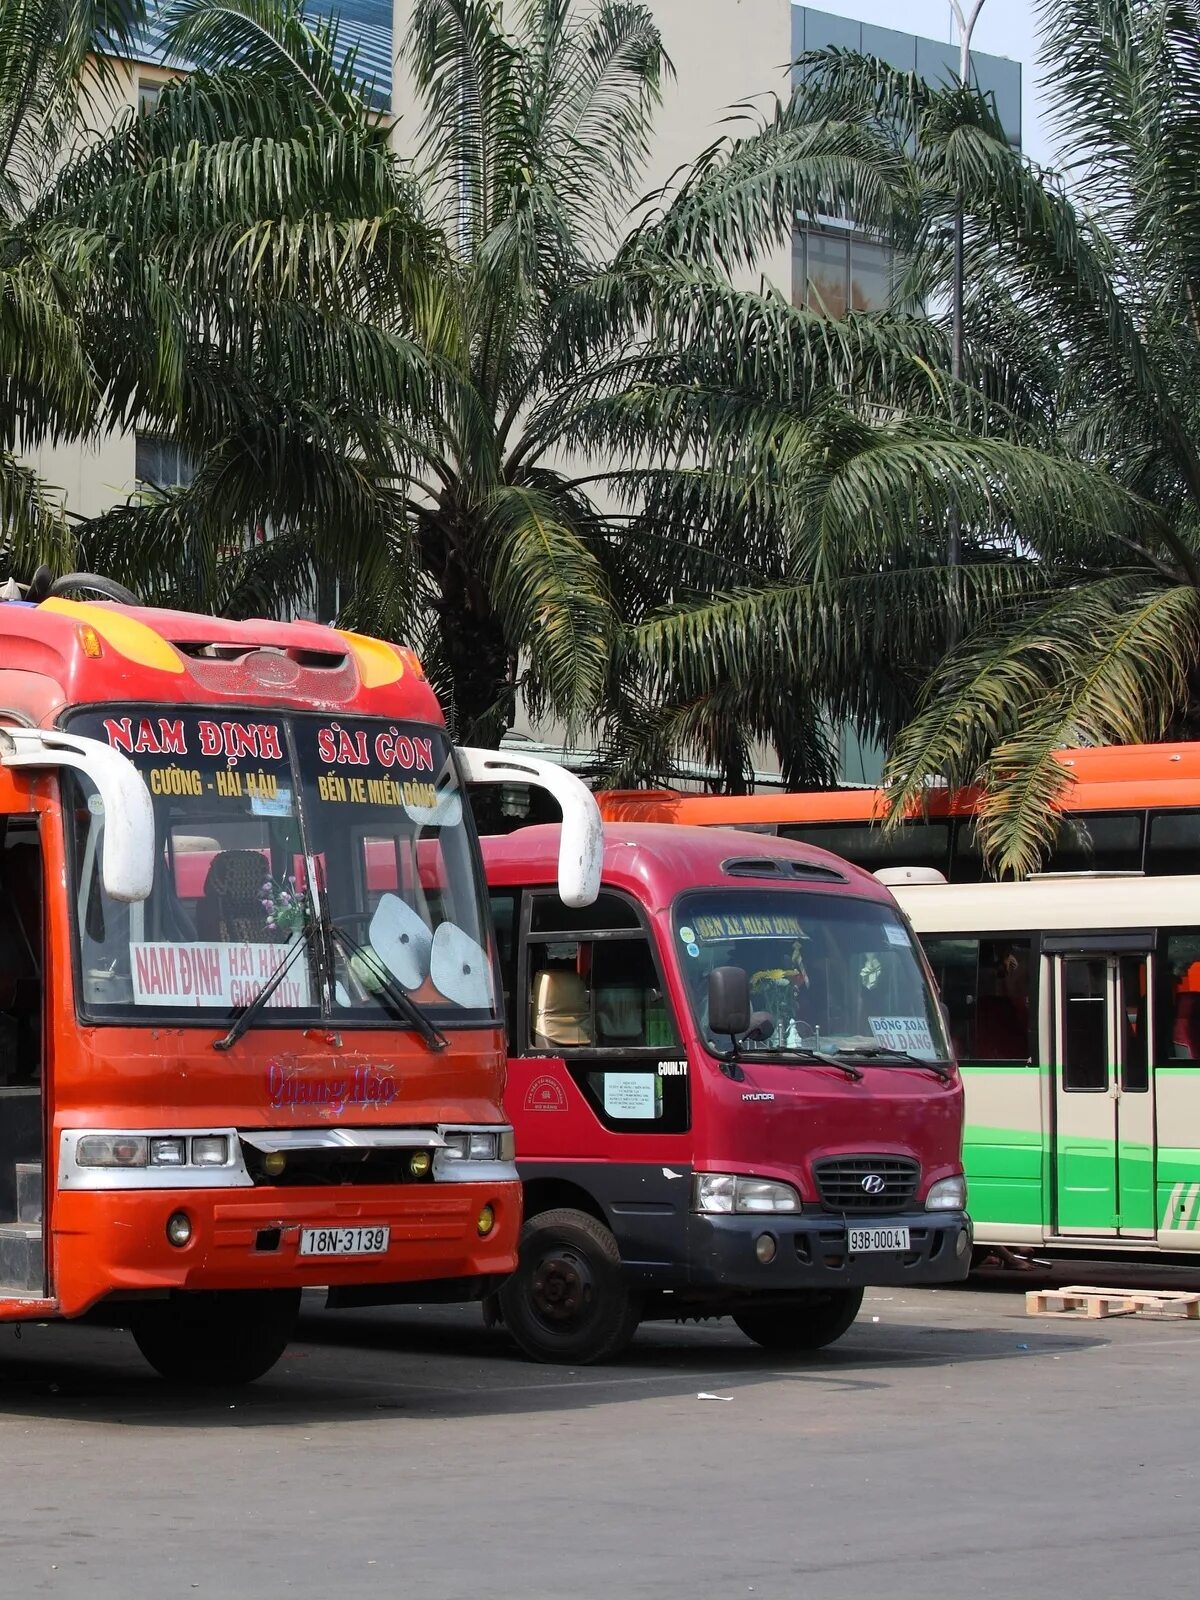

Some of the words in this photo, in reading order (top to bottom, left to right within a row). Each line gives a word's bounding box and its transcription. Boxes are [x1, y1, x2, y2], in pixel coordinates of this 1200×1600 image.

[103, 717, 188, 754] NAM
[197, 720, 283, 766] ĐỊNH
[318, 722, 370, 765] SÀI
[374, 726, 434, 772] GÒN
[150, 762, 203, 796] CƯỜNG
[215, 764, 243, 797] HẢI
[317, 770, 347, 802] BẾN
[347, 777, 367, 803] XE
[367, 773, 402, 806] MIỀN
[402, 778, 438, 809] ĐÔNG
[135, 946, 178, 996] NAM
[178, 947, 224, 1006] ĐỊNH
[228, 943, 254, 976] HẢI
[741, 1093, 775, 1101] HYUNDAI
[309, 1230, 385, 1252] 18N-3139
[851, 1230, 907, 1250] 93B-000.41
